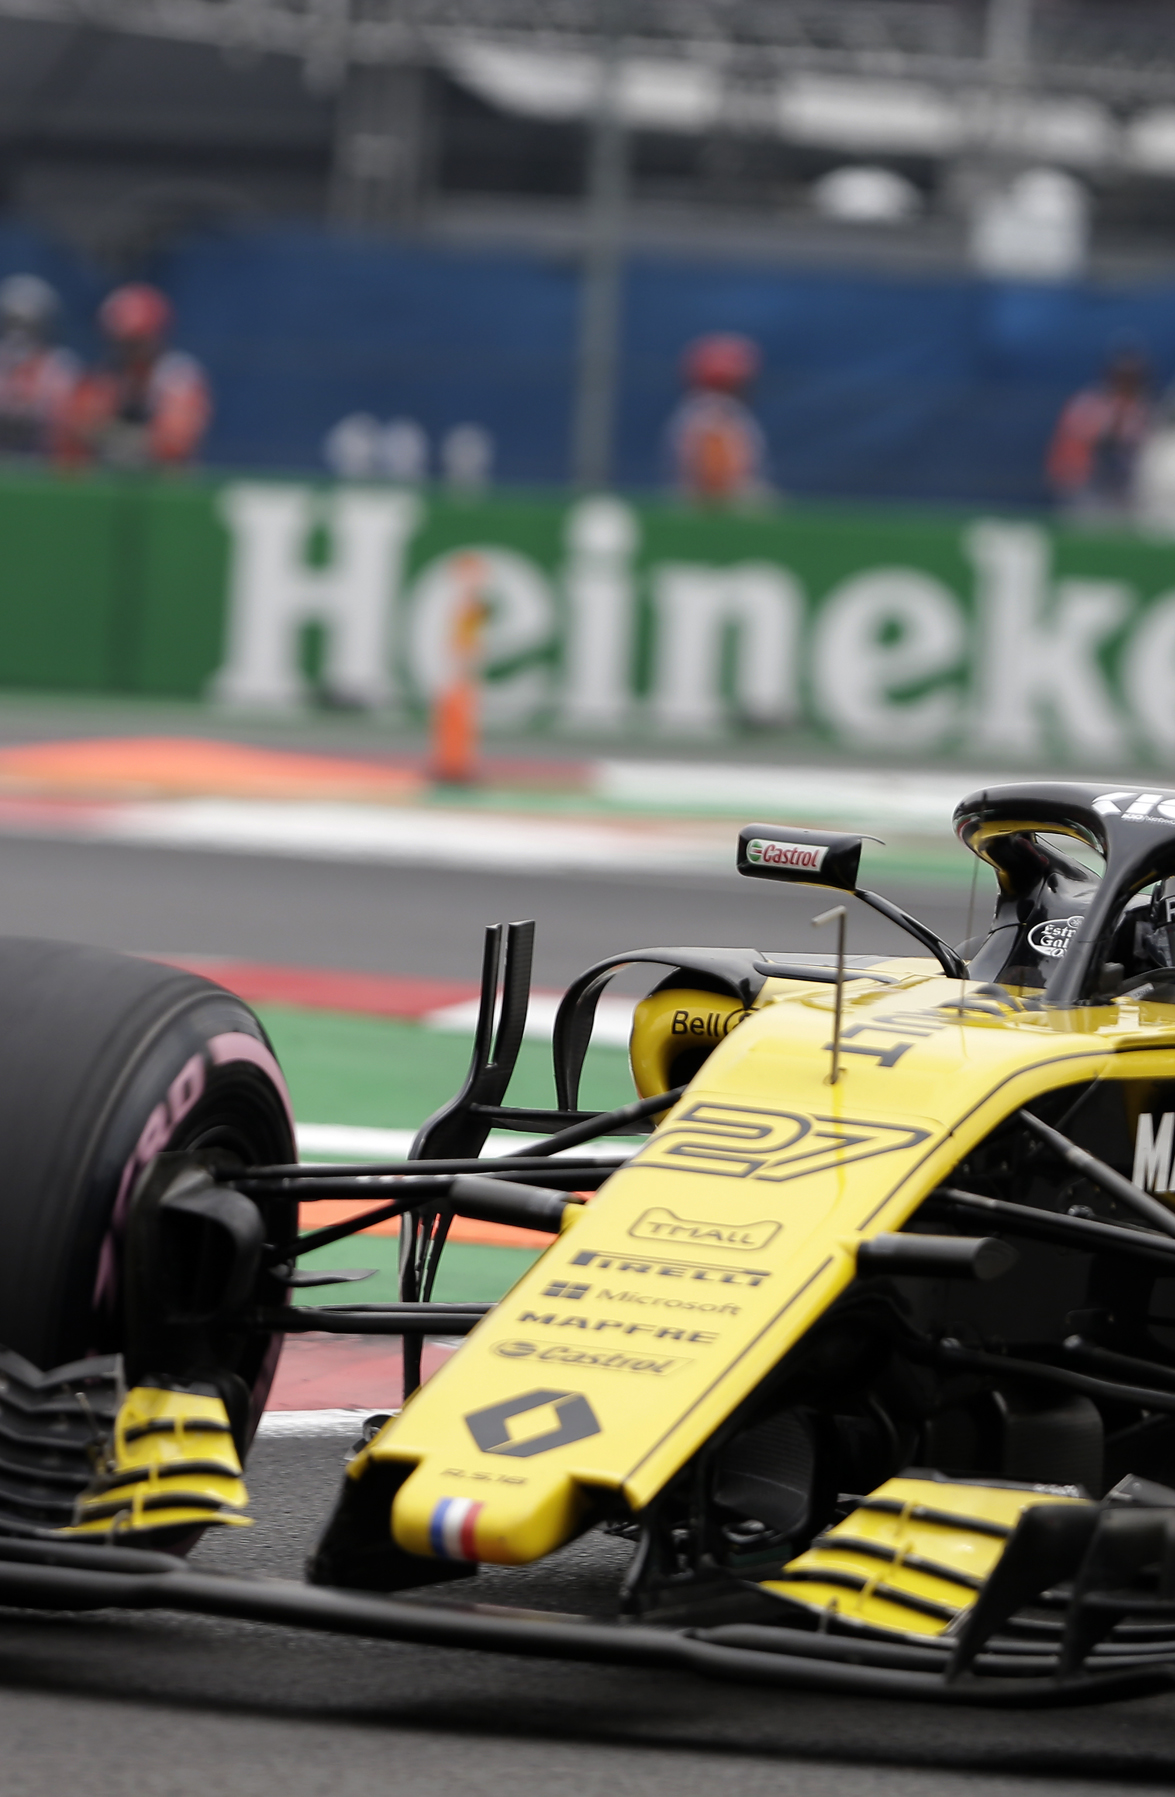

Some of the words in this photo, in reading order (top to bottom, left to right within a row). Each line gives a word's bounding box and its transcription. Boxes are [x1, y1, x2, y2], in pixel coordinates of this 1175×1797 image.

[763, 844, 820, 868] Castrol
[1041, 924, 1077, 938] Estr
[671, 1010, 721, 1037] Bell
[617, 1099, 933, 1182] 27
[568, 1250, 773, 1287] PIRELLI
[596, 1287, 743, 1316] Microsoft
[517, 1311, 721, 1344] MAPFRE
[534, 1346, 682, 1375] Castrol
